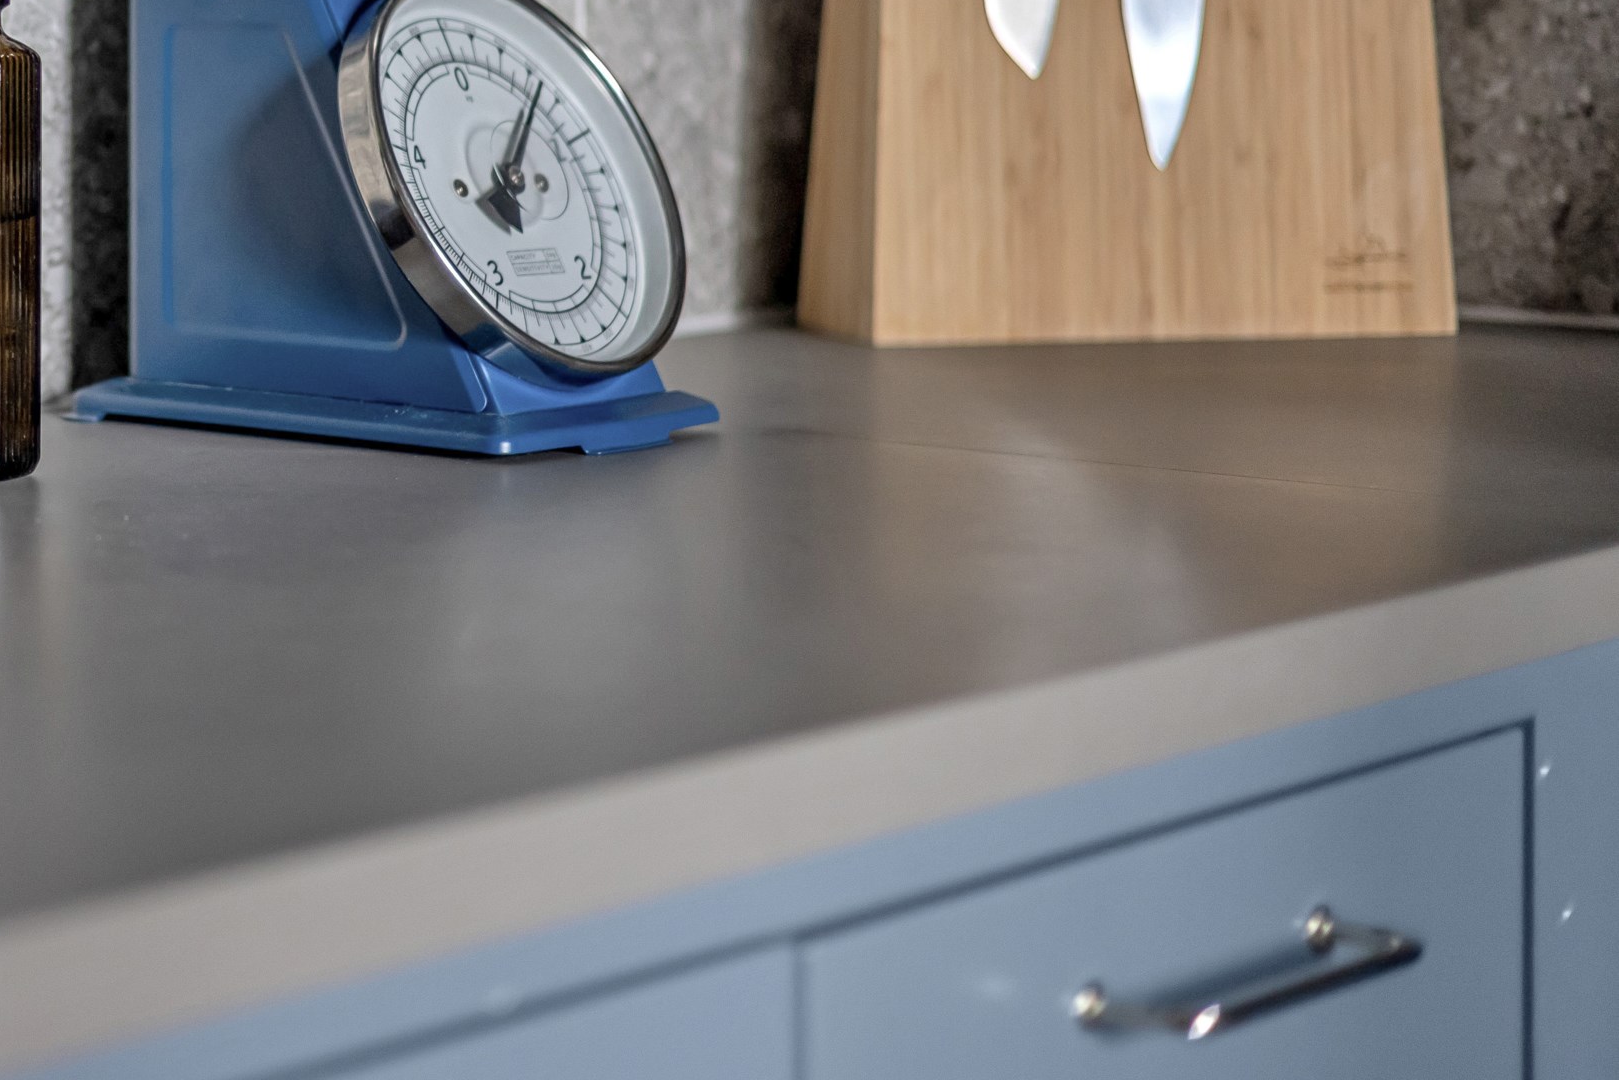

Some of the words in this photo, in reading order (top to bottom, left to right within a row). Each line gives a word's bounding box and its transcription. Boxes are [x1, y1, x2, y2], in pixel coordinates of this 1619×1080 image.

[454, 67, 470, 91] 0
[414, 144, 426, 169] 4
[487, 260, 504, 286] 3
[574, 254, 592, 280] 2
